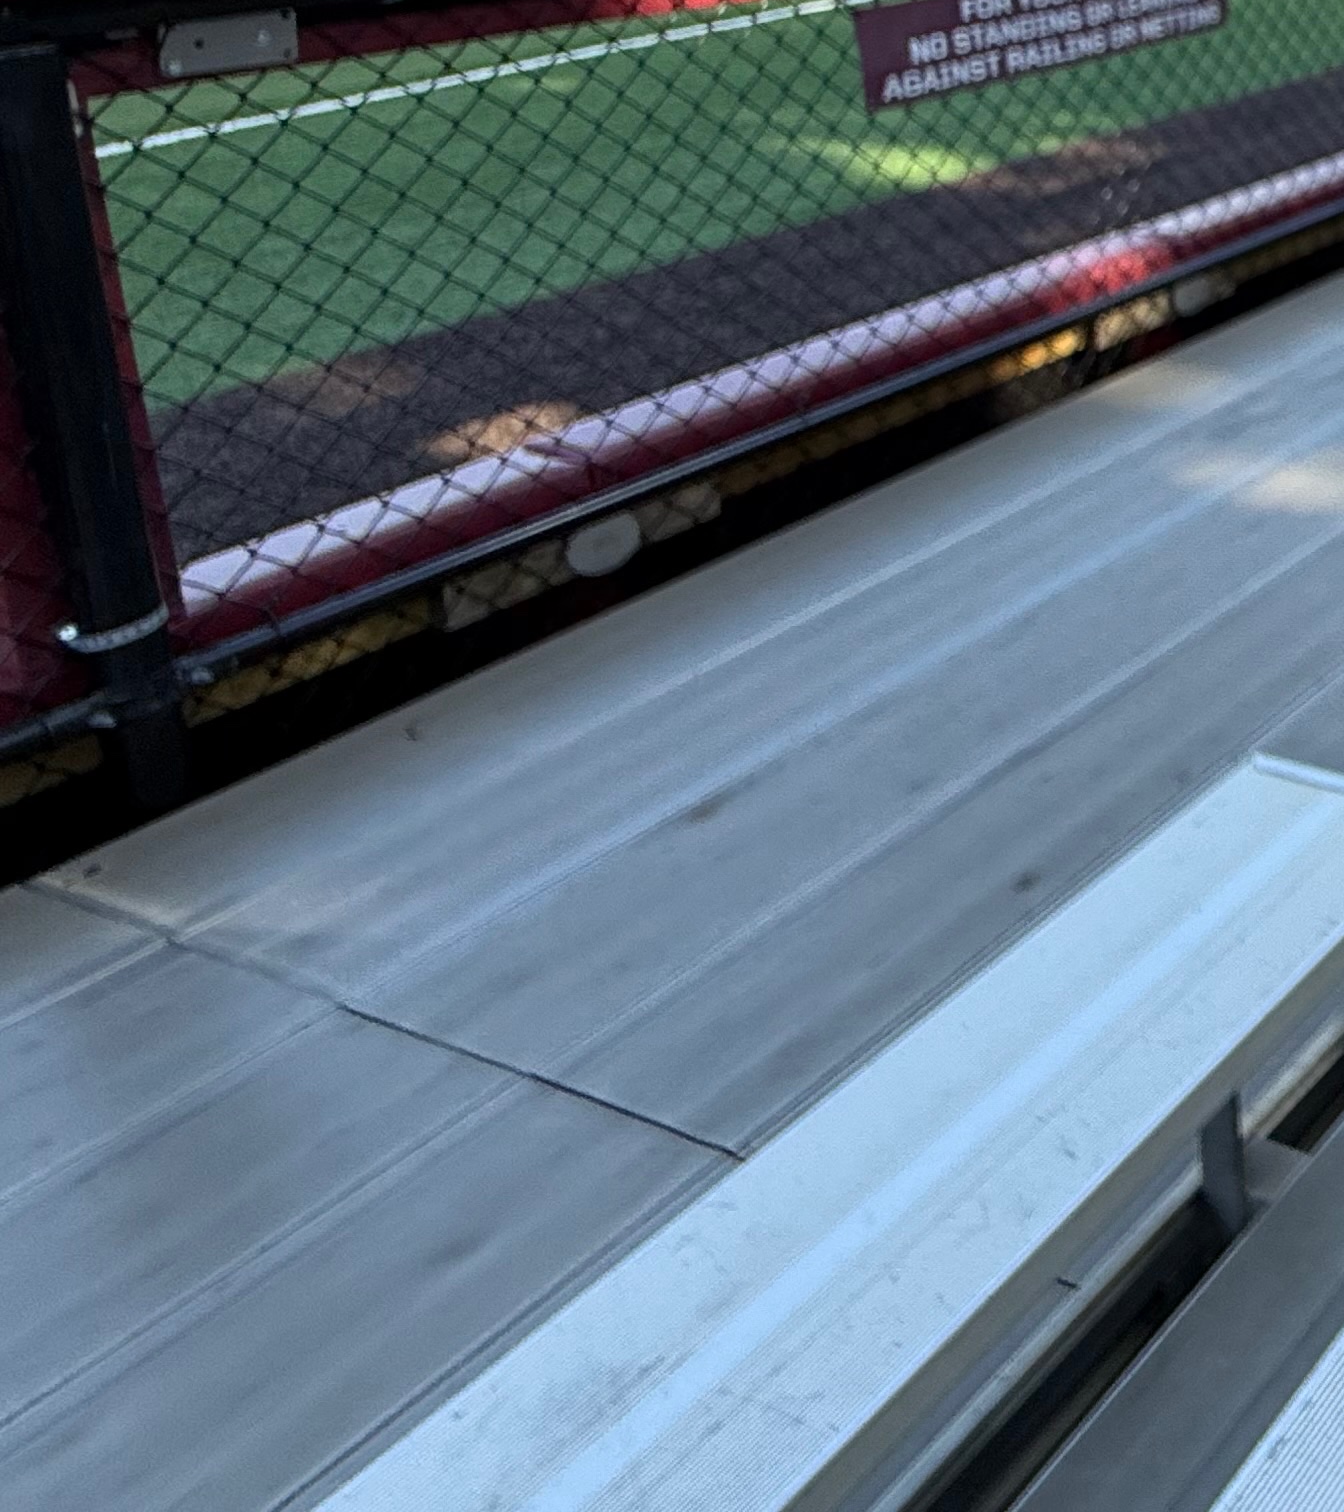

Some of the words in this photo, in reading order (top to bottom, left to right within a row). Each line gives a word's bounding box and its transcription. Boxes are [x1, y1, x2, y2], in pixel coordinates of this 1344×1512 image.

[883, 54, 1000, 104] AGAINST
[1003, 35, 1106, 75] RAILING
[1109, 20, 1139, 50] OR
[1140, 0, 1222, 41] NETTING
[908, 31, 948, 65] NO
[951, 5, 1083, 57] STANDING
